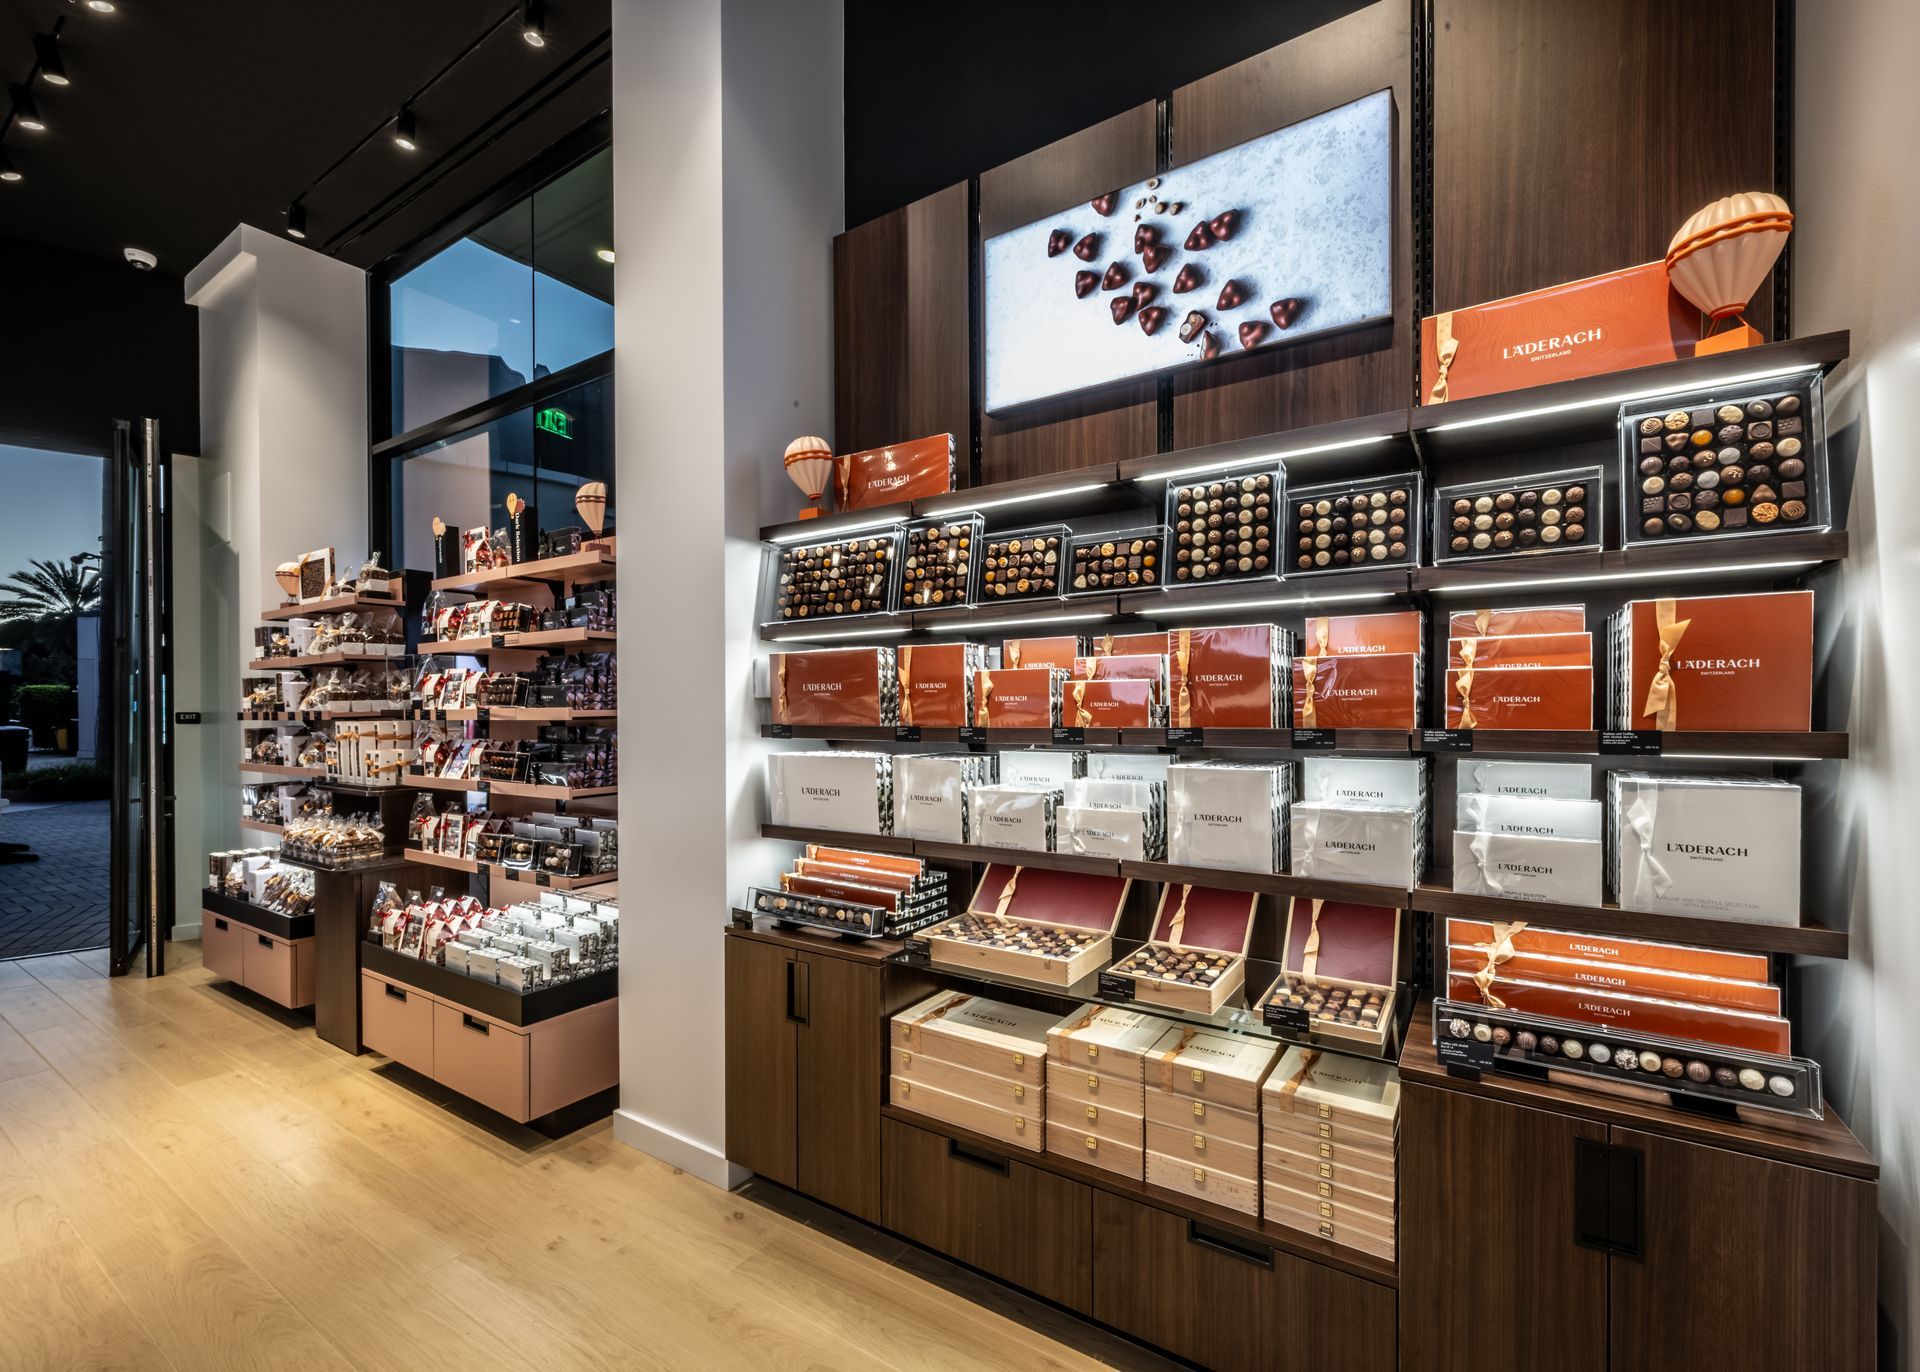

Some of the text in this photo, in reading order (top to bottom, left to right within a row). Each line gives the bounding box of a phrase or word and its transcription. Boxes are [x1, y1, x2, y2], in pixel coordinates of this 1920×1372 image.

[1503, 328, 1602, 360] LÄDERACH
[1530, 348, 1572, 362] SWITZERLAND
[868, 474, 910, 489] LÄDERACH
[1338, 645, 1386, 654] LÄDERACH
[1677, 658, 1760, 669] LÄDERACH
[1195, 673, 1243, 682] LÄDERACH
[802, 682, 842, 692] LÄDERACH
[915, 682, 947, 690] LÄDERACH
[1327, 688, 1378, 698] LÄDERACH
[1493, 695, 1541, 703] LÄDERACH
[801, 787, 841, 797] LÄDERACH
[1336, 790, 1384, 798] LÄDERACH
[1498, 786, 1547, 795] LÄDERACH
[910, 795, 942, 803] LÄDERACH
[989, 816, 1021, 825] LÄDERACH
[1194, 814, 1242, 823] LÄDERACH
[1501, 825, 1554, 834] LÄDERACH
[1325, 841, 1376, 851] LÄDERACH
[1667, 843, 1748, 857] LÄDERACH
[1498, 863, 1553, 874] LÄDERACH
[1569, 944, 1619, 956] LÄDERACH
[1575, 973, 1626, 986] LÄDERACH
[1578, 1002, 1631, 1017] LÄDERACH
[964, 1011, 1016, 1026] LÄDERACH
